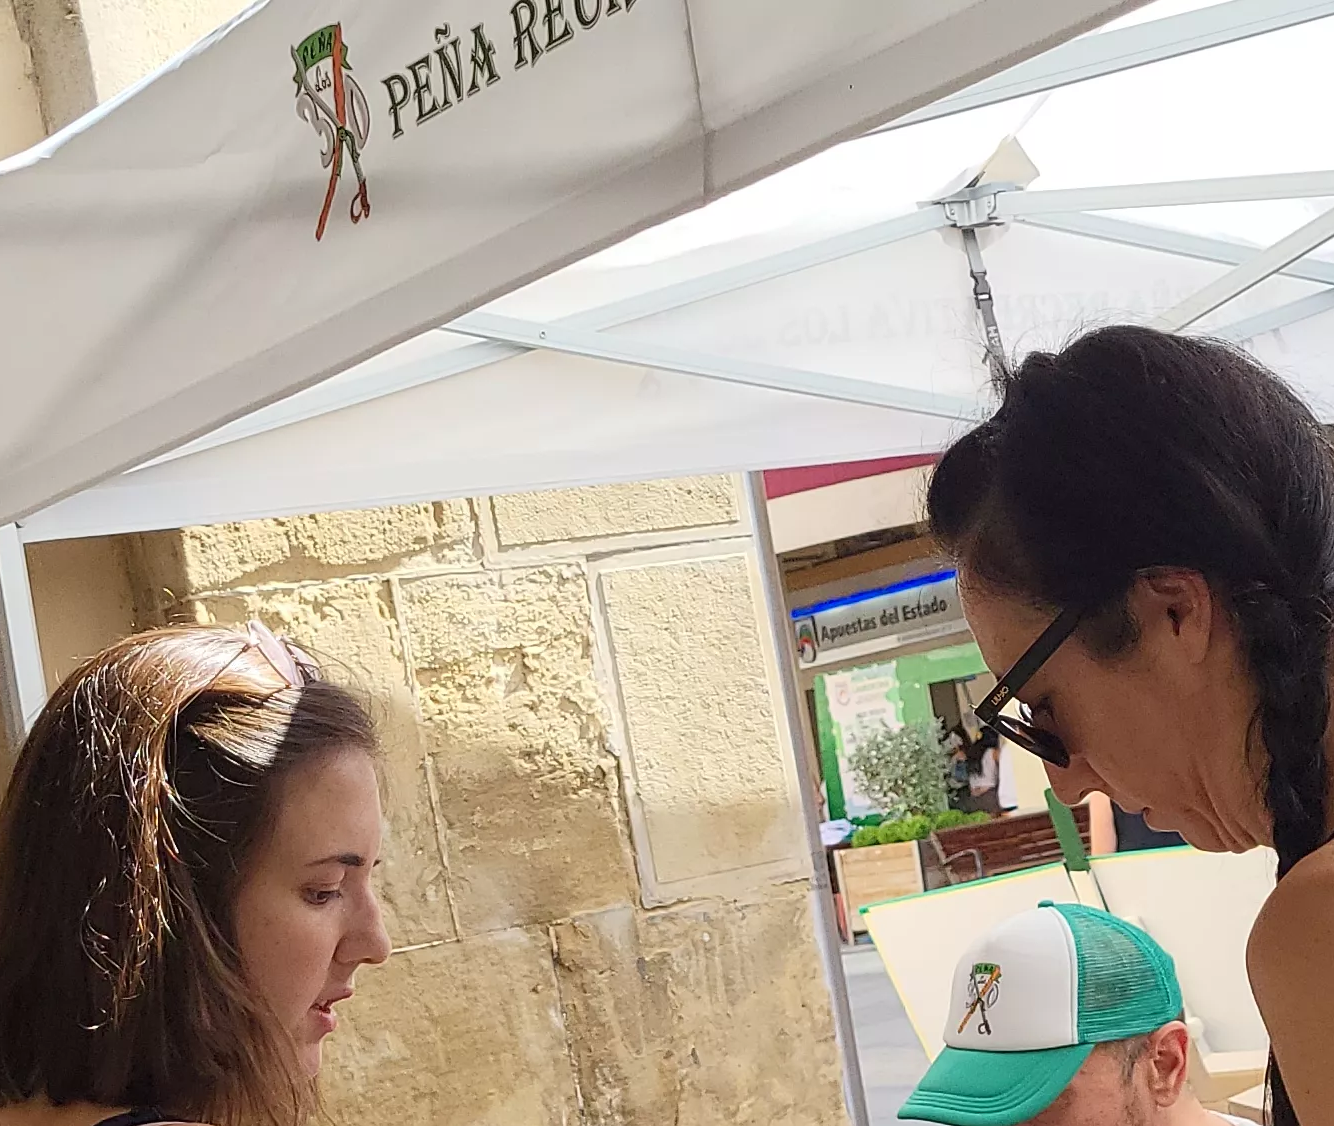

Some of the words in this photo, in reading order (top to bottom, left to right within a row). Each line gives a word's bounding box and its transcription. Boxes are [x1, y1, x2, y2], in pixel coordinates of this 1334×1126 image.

[380, 22, 501, 139] PEÑA
[821, 616, 877, 642] Apuestas
[880, 607, 899, 627] del
[902, 596, 948, 621] Estado
